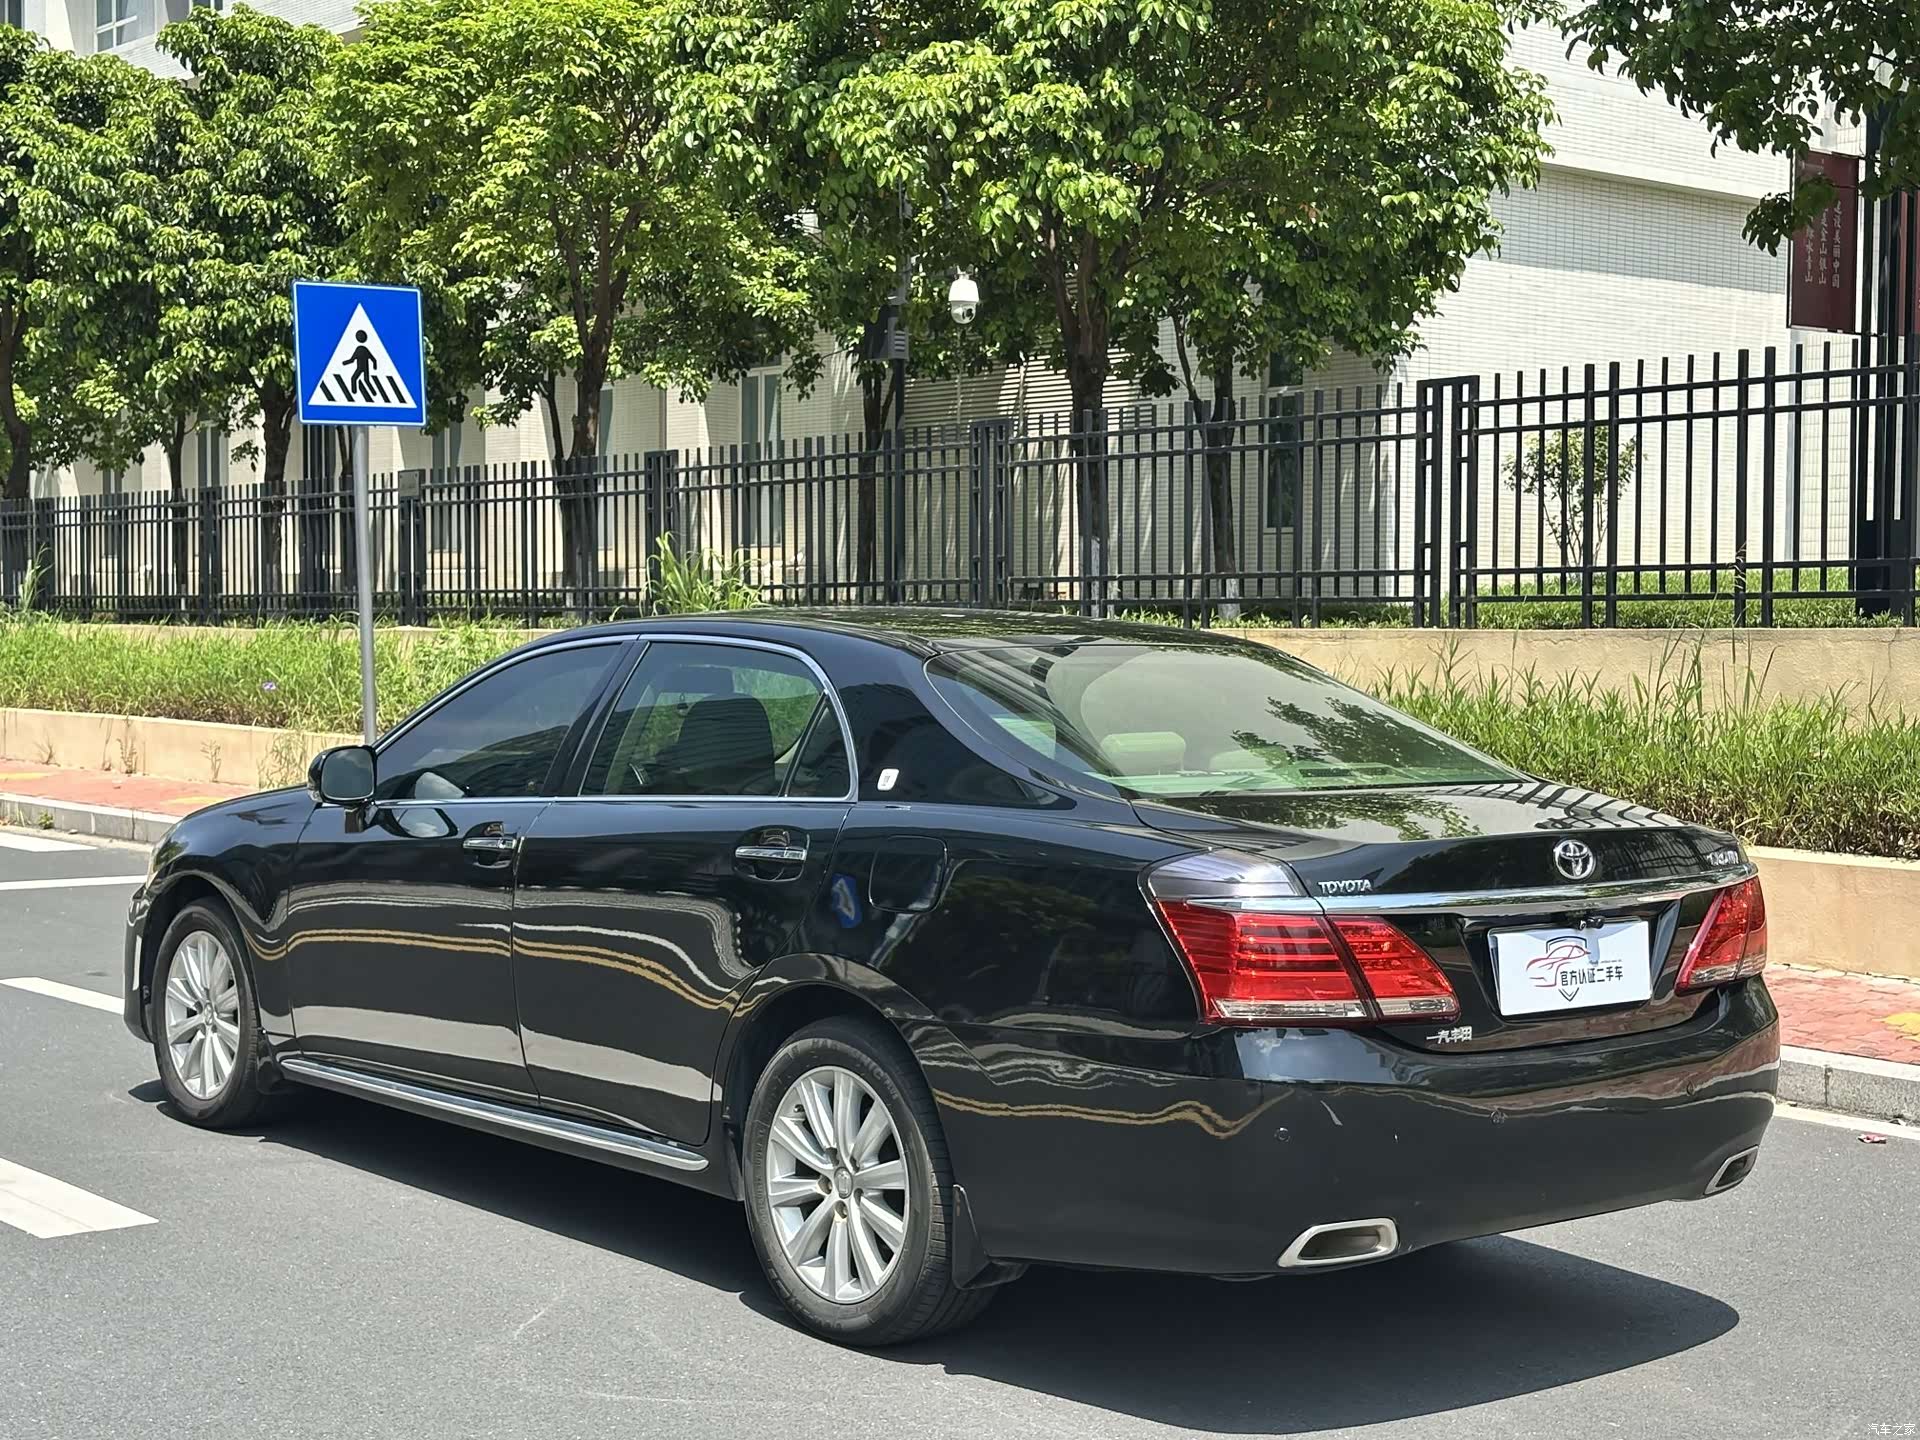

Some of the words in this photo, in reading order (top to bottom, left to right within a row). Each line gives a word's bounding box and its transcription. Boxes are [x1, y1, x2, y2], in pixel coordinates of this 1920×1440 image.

[1317, 879, 1373, 894] TOYOTA
[1560, 965, 1624, 986] 官方认证二手车
